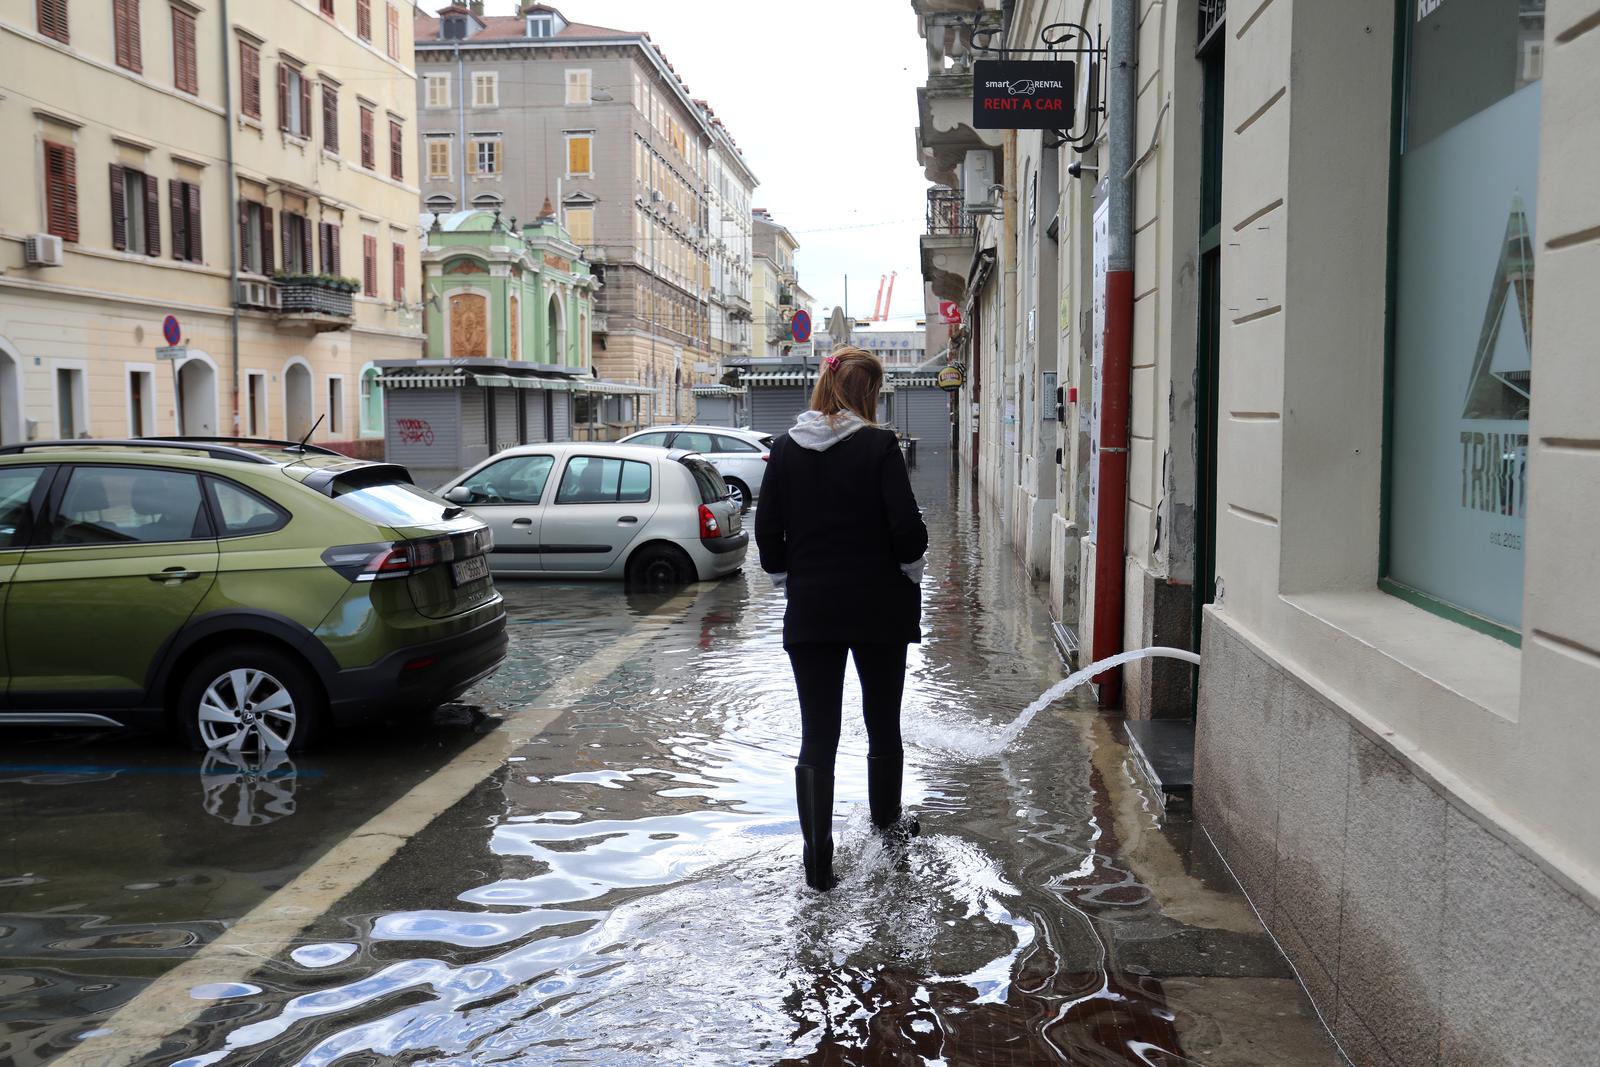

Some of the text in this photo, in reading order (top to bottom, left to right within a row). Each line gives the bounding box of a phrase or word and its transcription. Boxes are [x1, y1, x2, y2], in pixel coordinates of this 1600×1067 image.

[984, 98, 1062, 110] RENT A CAR
